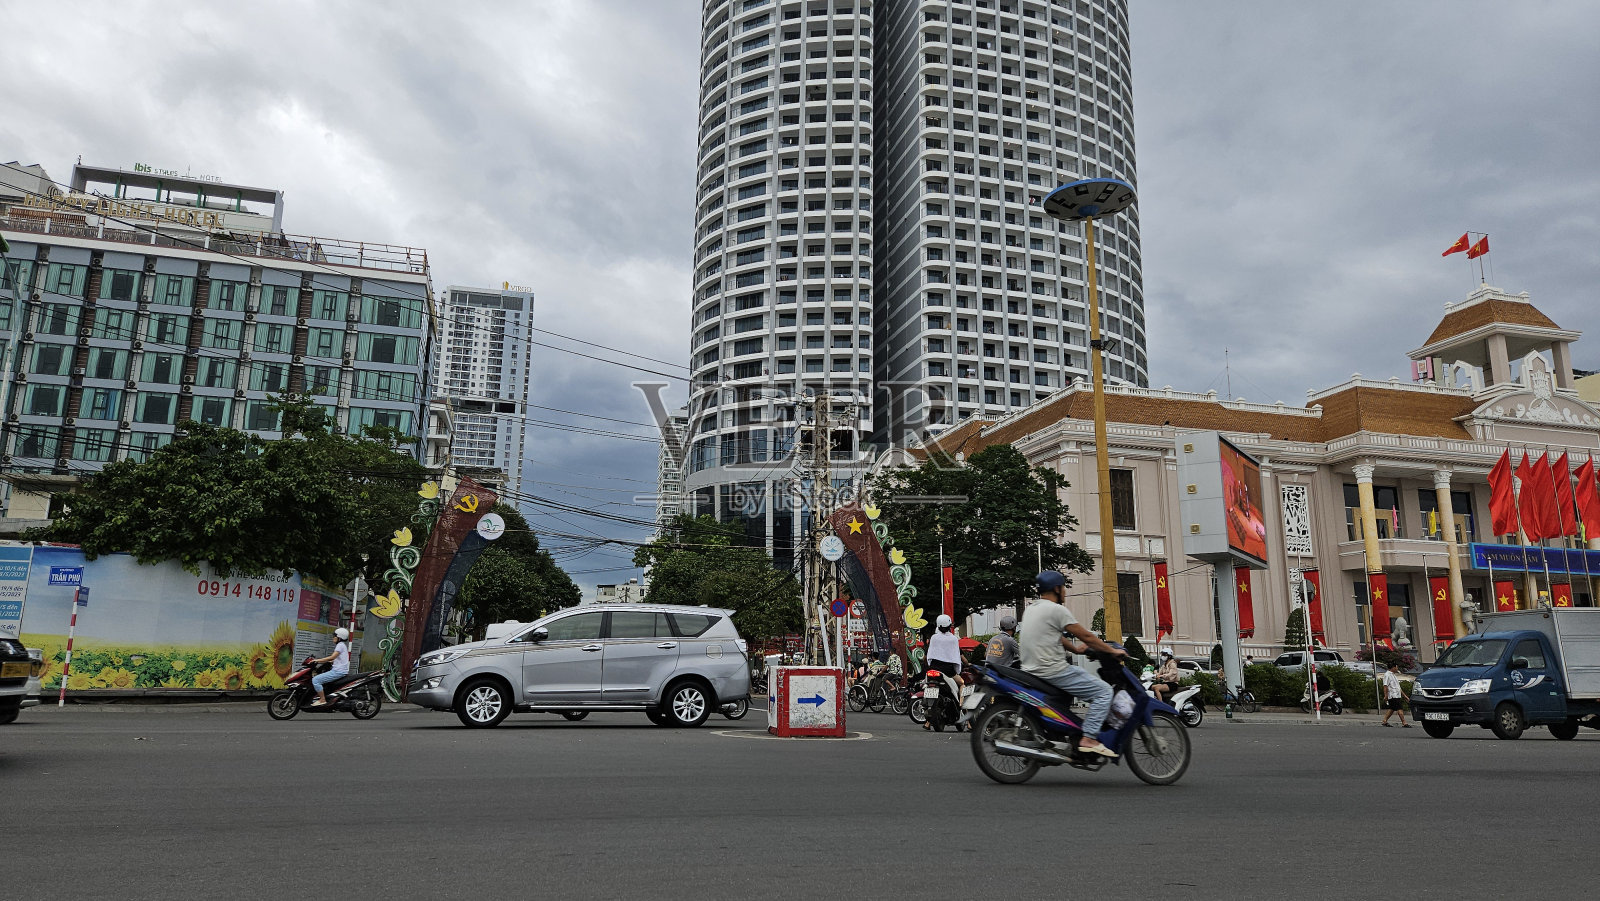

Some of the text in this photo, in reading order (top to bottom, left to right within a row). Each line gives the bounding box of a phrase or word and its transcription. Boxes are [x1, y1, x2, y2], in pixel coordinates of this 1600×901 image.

[96, 199, 155, 220] LIGHT
[164, 207, 225, 228] HOTEL
[68, 573, 80, 581] PHÚ
[197, 580, 294, 602] 0914 148 119
